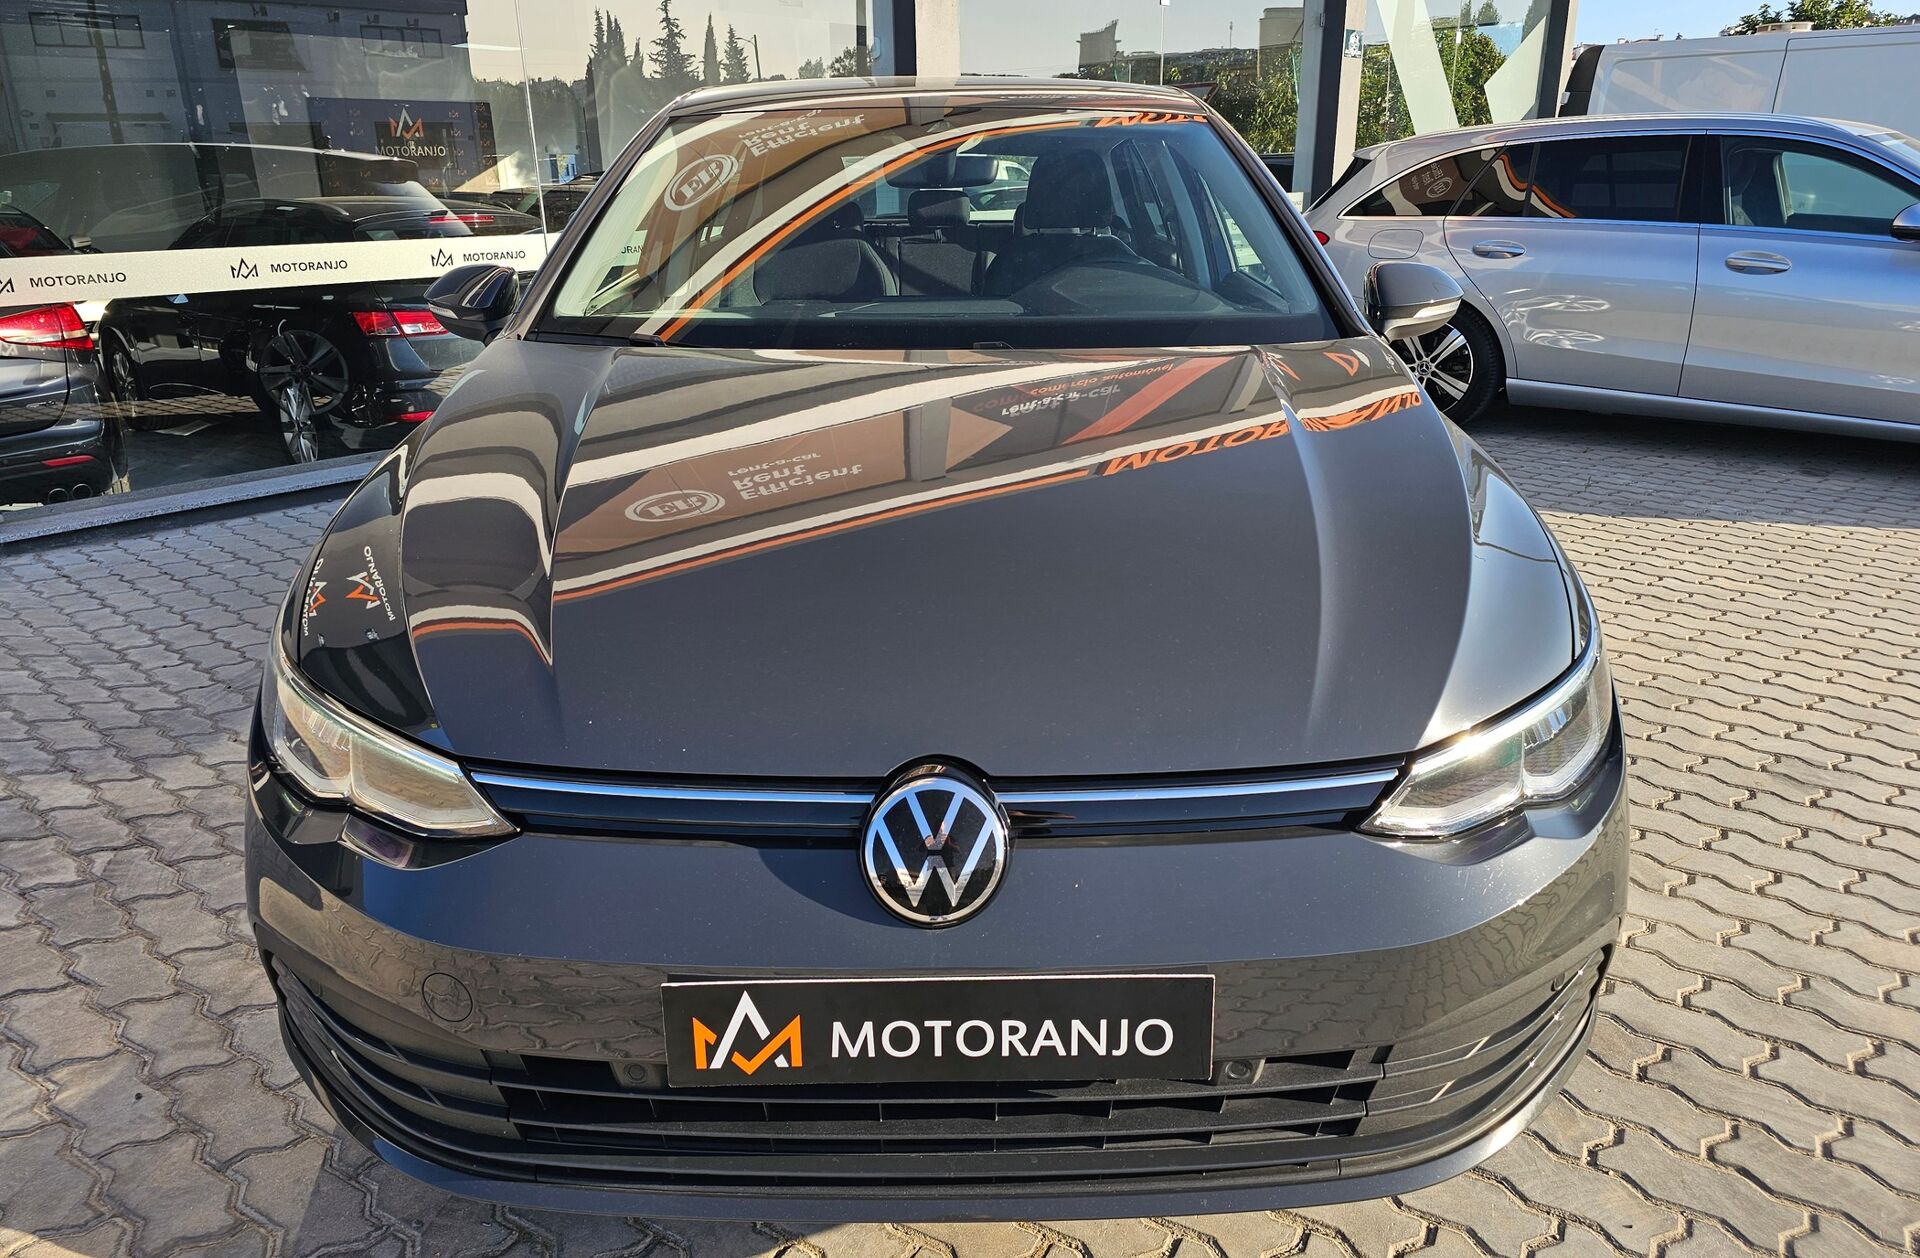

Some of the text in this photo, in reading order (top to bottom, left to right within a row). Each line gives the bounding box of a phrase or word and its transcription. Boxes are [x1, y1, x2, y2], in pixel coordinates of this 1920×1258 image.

[375, 145, 446, 157] MOTORANJO
[463, 250, 526, 262] MOTORANJO
[270, 259, 348, 273] MOTORANJO
[29, 272, 127, 288] MOTORANJO
[831, 1018, 1174, 1059] MOTORANJO
